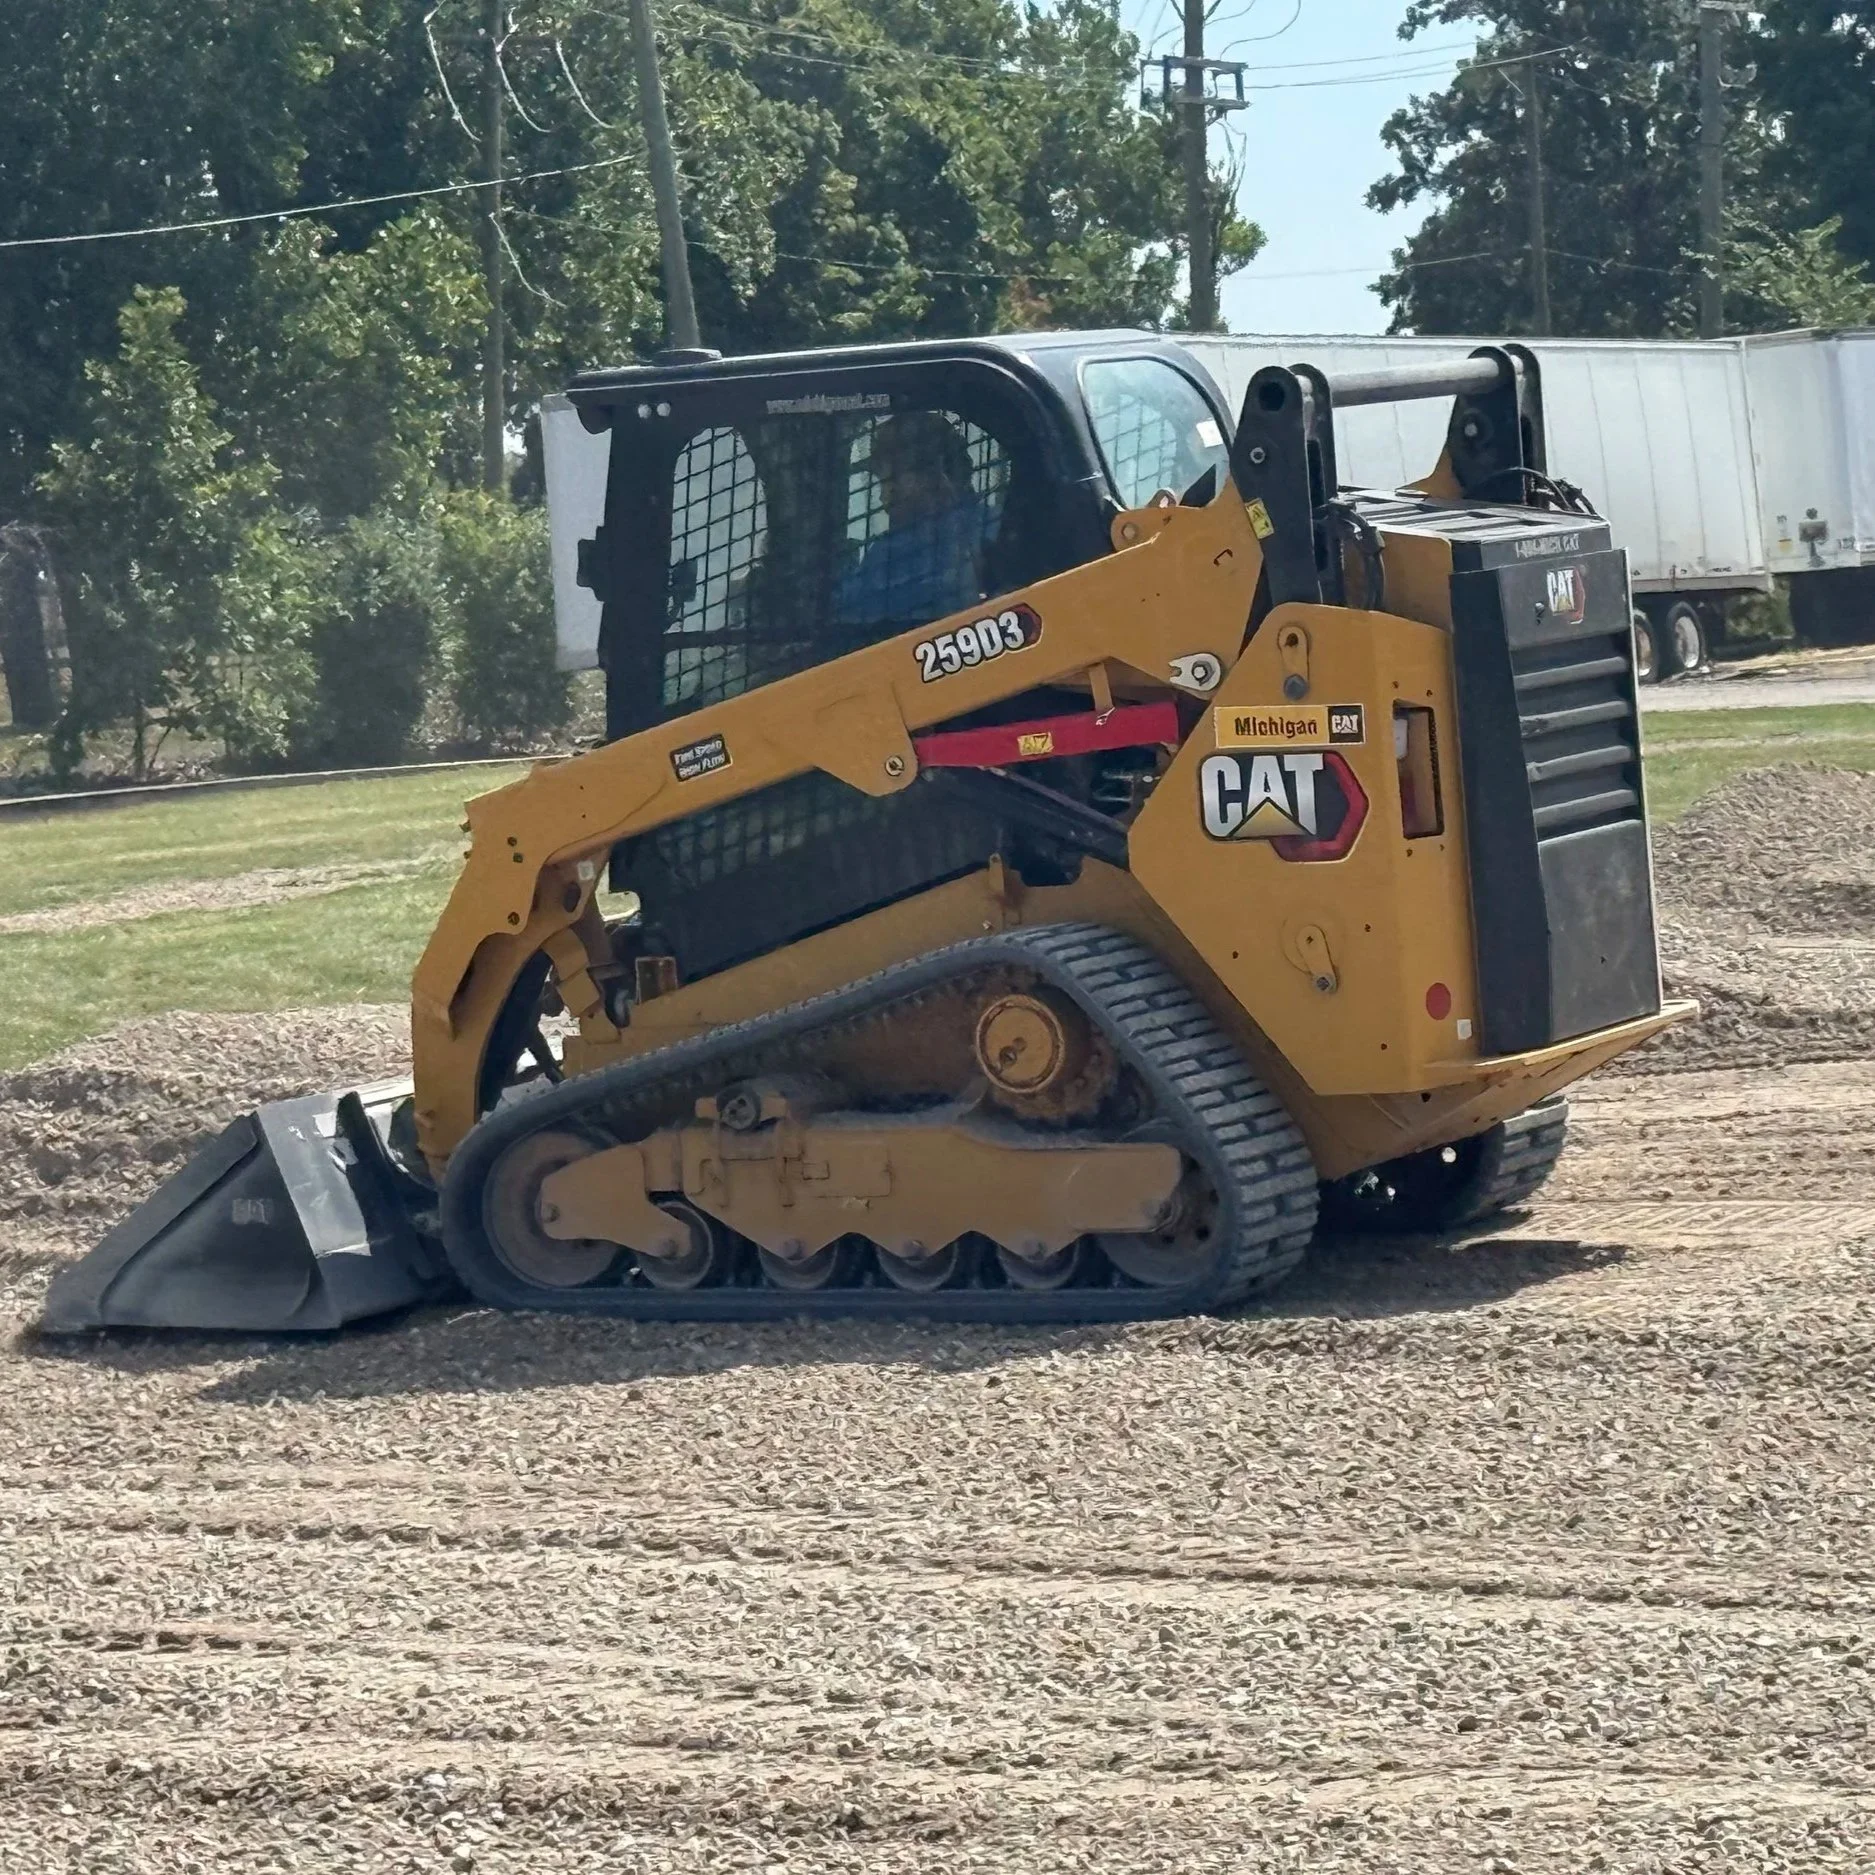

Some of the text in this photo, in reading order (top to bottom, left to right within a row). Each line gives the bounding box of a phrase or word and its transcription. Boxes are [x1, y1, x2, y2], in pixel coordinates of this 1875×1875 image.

[1547, 569, 1575, 612] CAT
[914, 611, 1025, 683] 259D3
[1234, 714, 1359, 739] Michigan CAT
[1201, 753, 1324, 837] CAT
